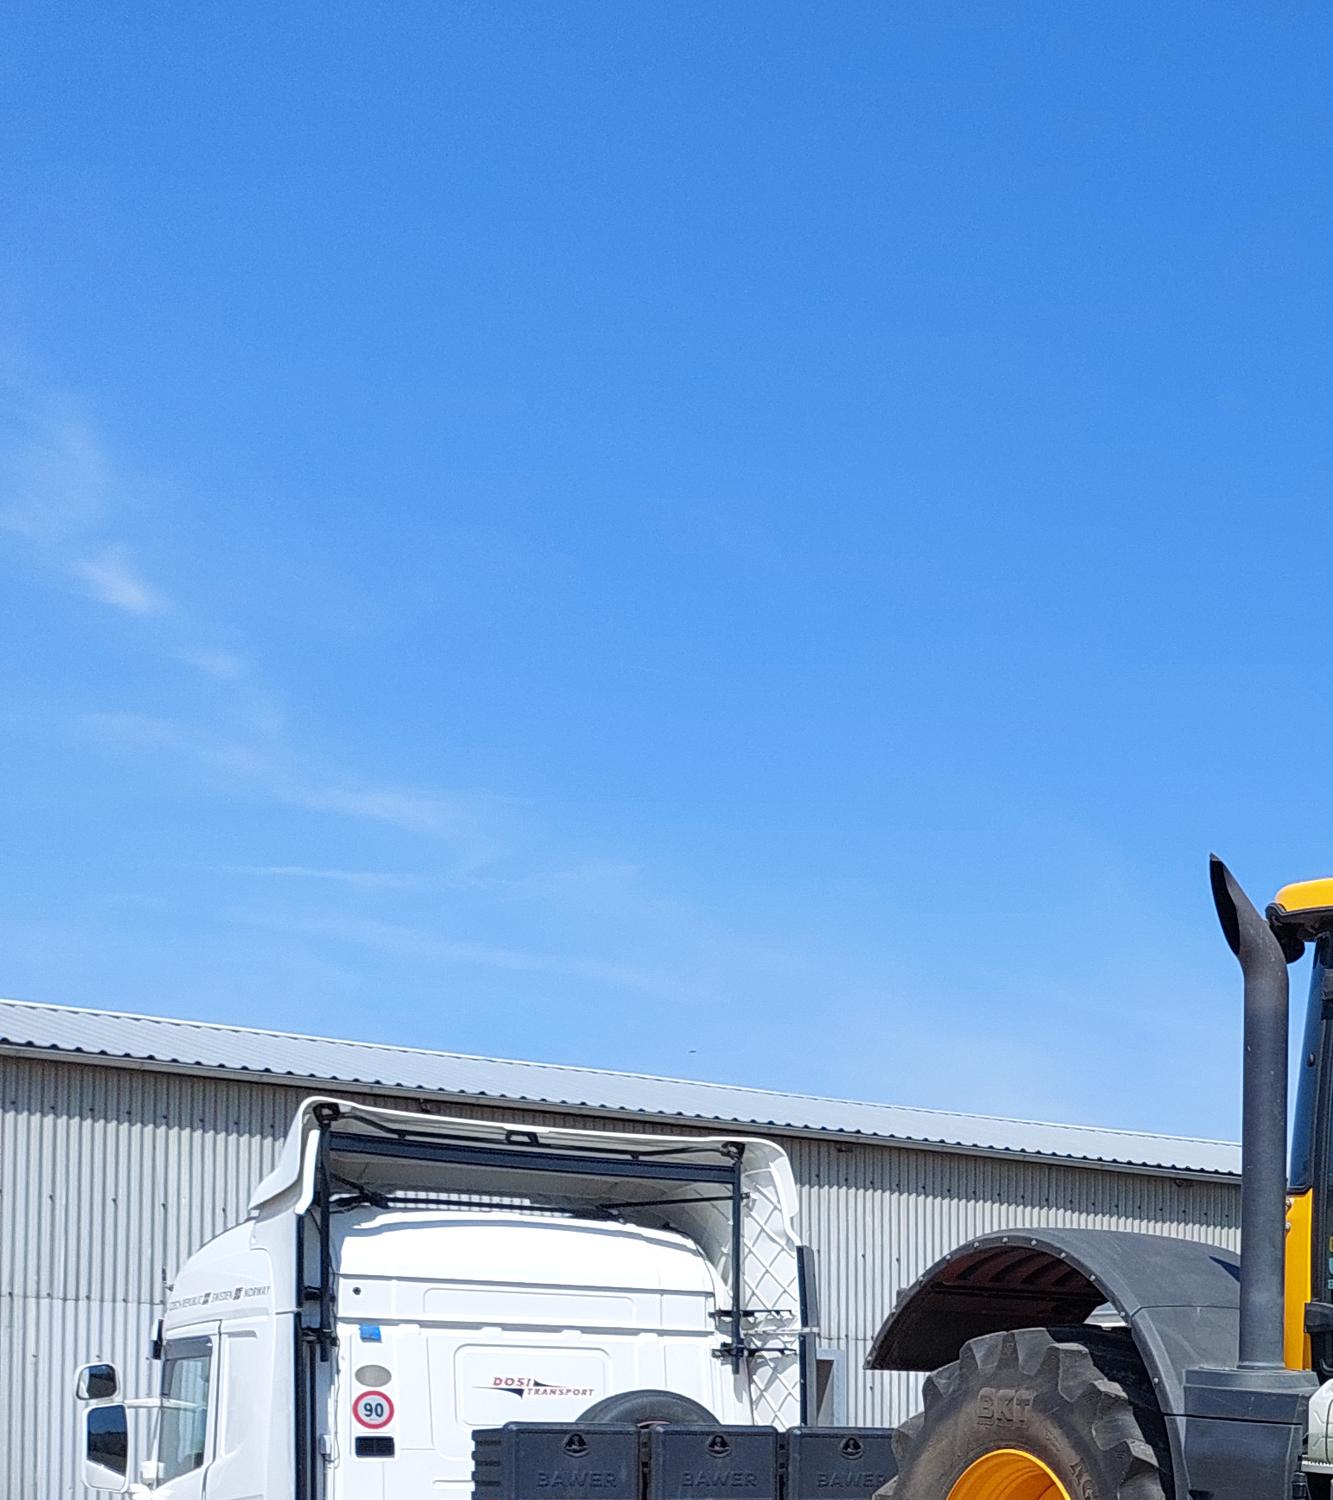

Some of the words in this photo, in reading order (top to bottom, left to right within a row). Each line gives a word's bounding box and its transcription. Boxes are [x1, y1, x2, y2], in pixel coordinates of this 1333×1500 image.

[492, 1376, 532, 1387] DOSI
[527, 1388, 595, 1397] TRANSPORT
[363, 1402, 385, 1418] 90
[977, 1387, 1036, 1430] BKT
[535, 1471, 618, 1489] BAWER
[680, 1470, 759, 1488] BAWER
